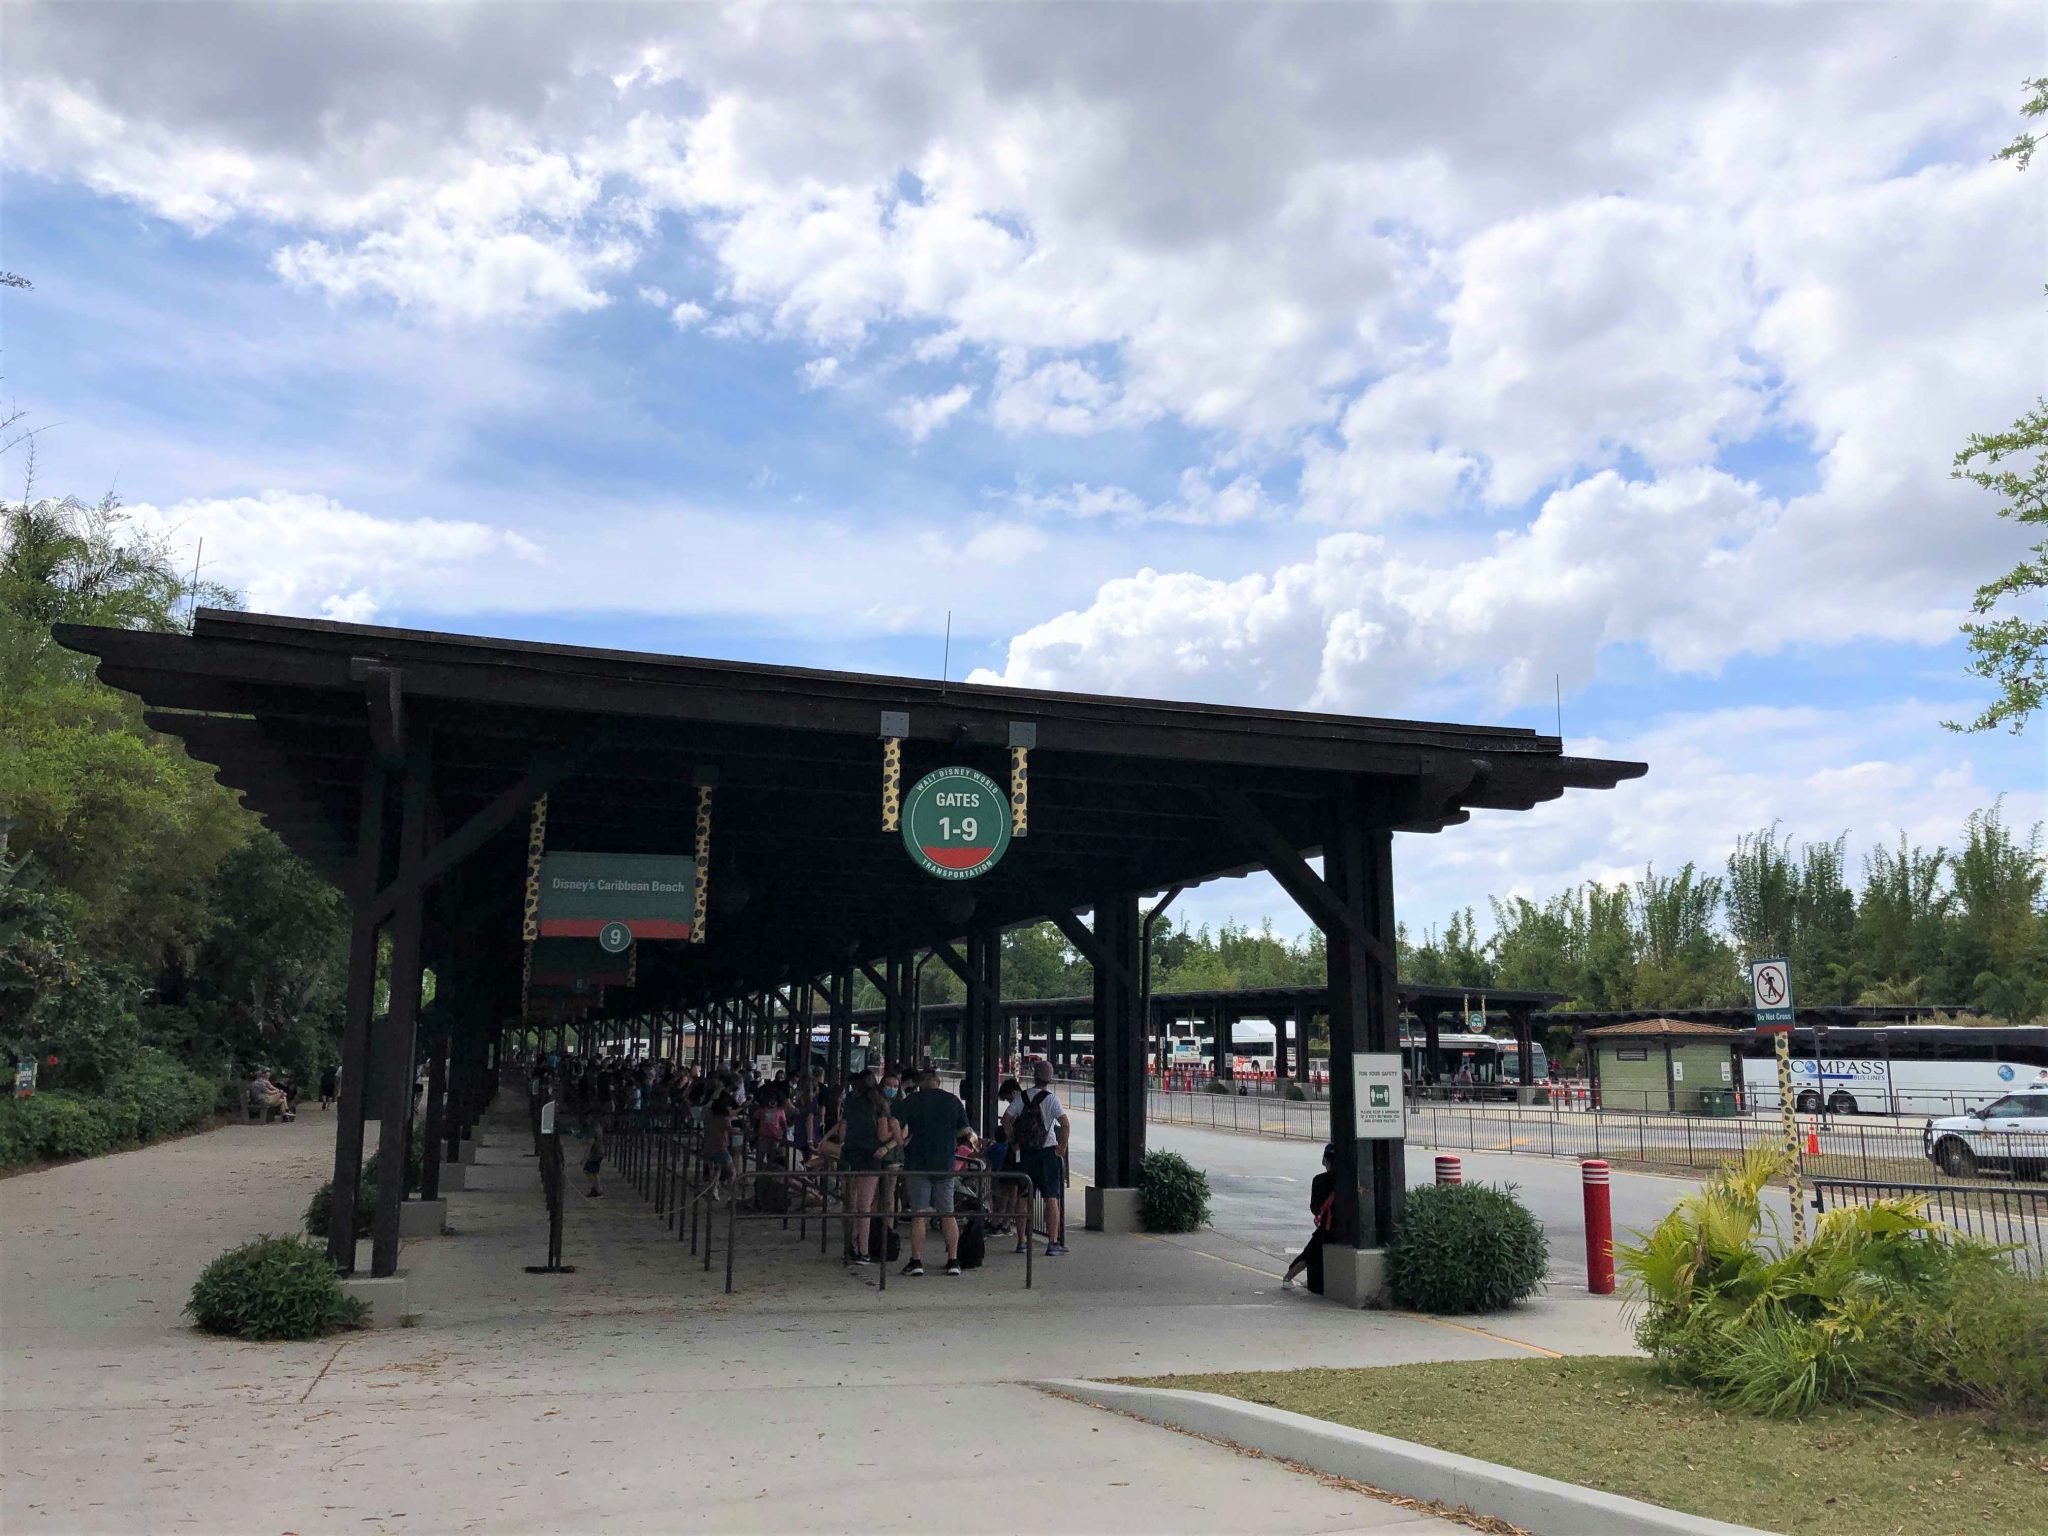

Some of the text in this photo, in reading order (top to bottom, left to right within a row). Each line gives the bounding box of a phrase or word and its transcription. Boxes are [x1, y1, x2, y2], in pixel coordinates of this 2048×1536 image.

[916, 768, 998, 795] WALT DISNEY WORLD
[936, 792, 980, 808] GATES
[938, 817, 978, 841] 1-9
[922, 858, 993, 879] TRANSPORTATION
[552, 878, 685, 893] Disney's Caribbean Beach
[609, 929, 621, 945] 9
[1757, 1012, 1791, 1021] Do Not Cross
[1791, 1060, 1885, 1075] COMPASS
